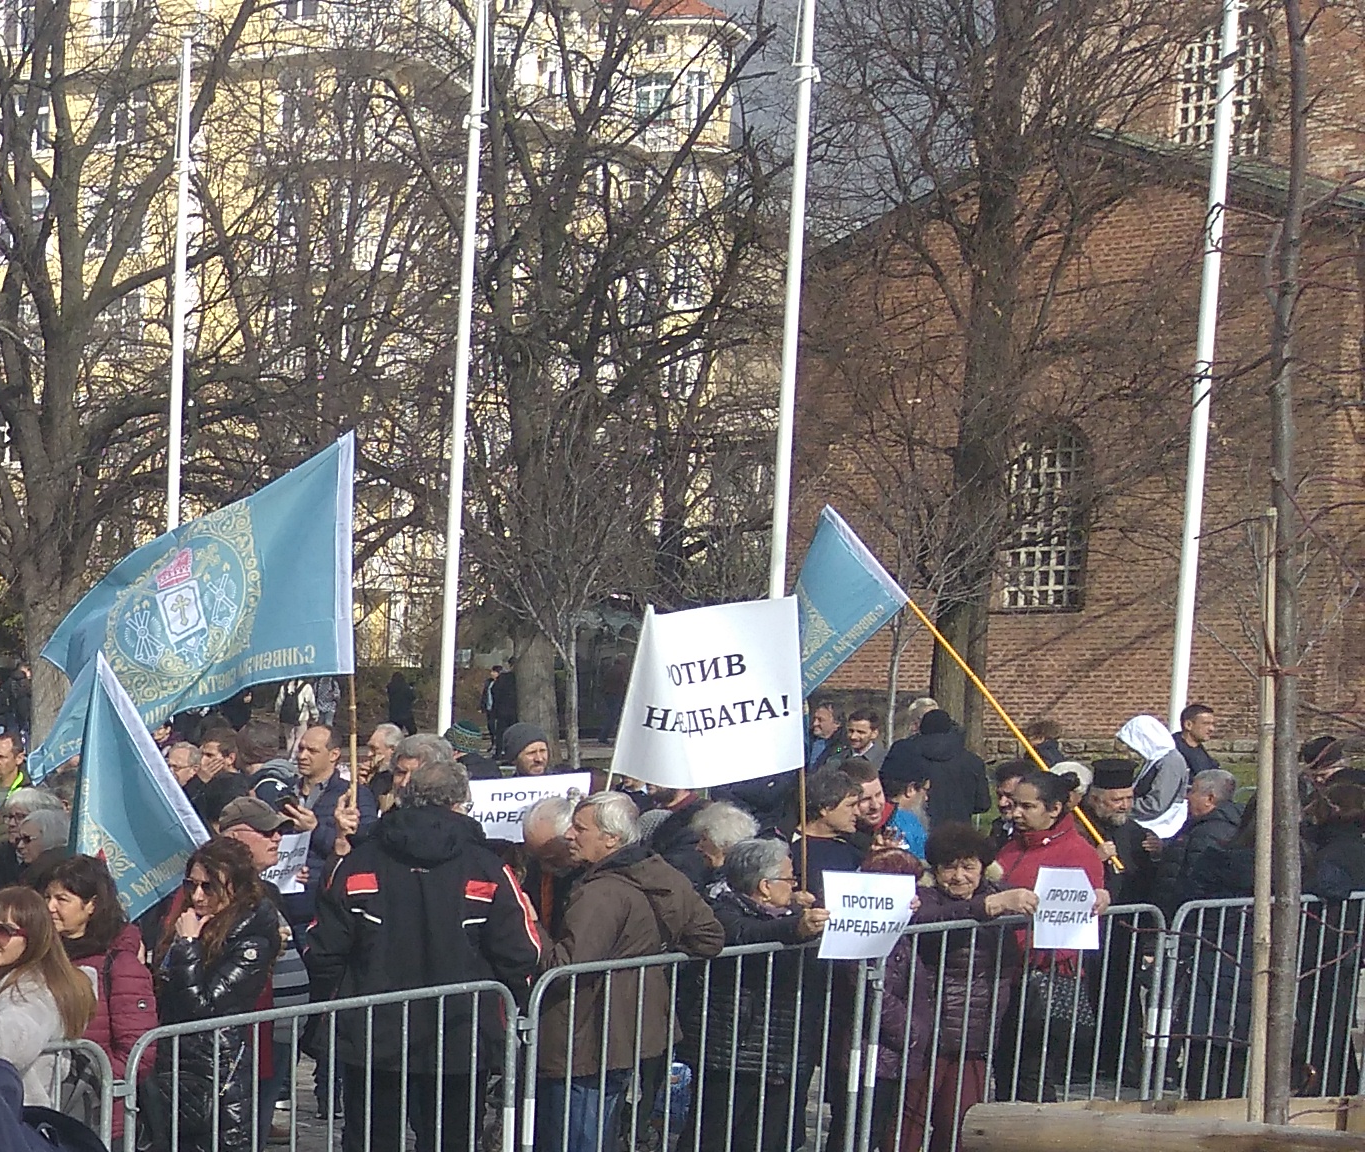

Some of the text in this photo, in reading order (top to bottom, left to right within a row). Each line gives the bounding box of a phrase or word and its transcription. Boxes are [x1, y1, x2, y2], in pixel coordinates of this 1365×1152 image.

[842, 894, 894, 911] ПРОТИВ
[1046, 889, 1089, 902] ПРОТИВ
[828, 919, 906, 938] НАРЕДБАТА!
